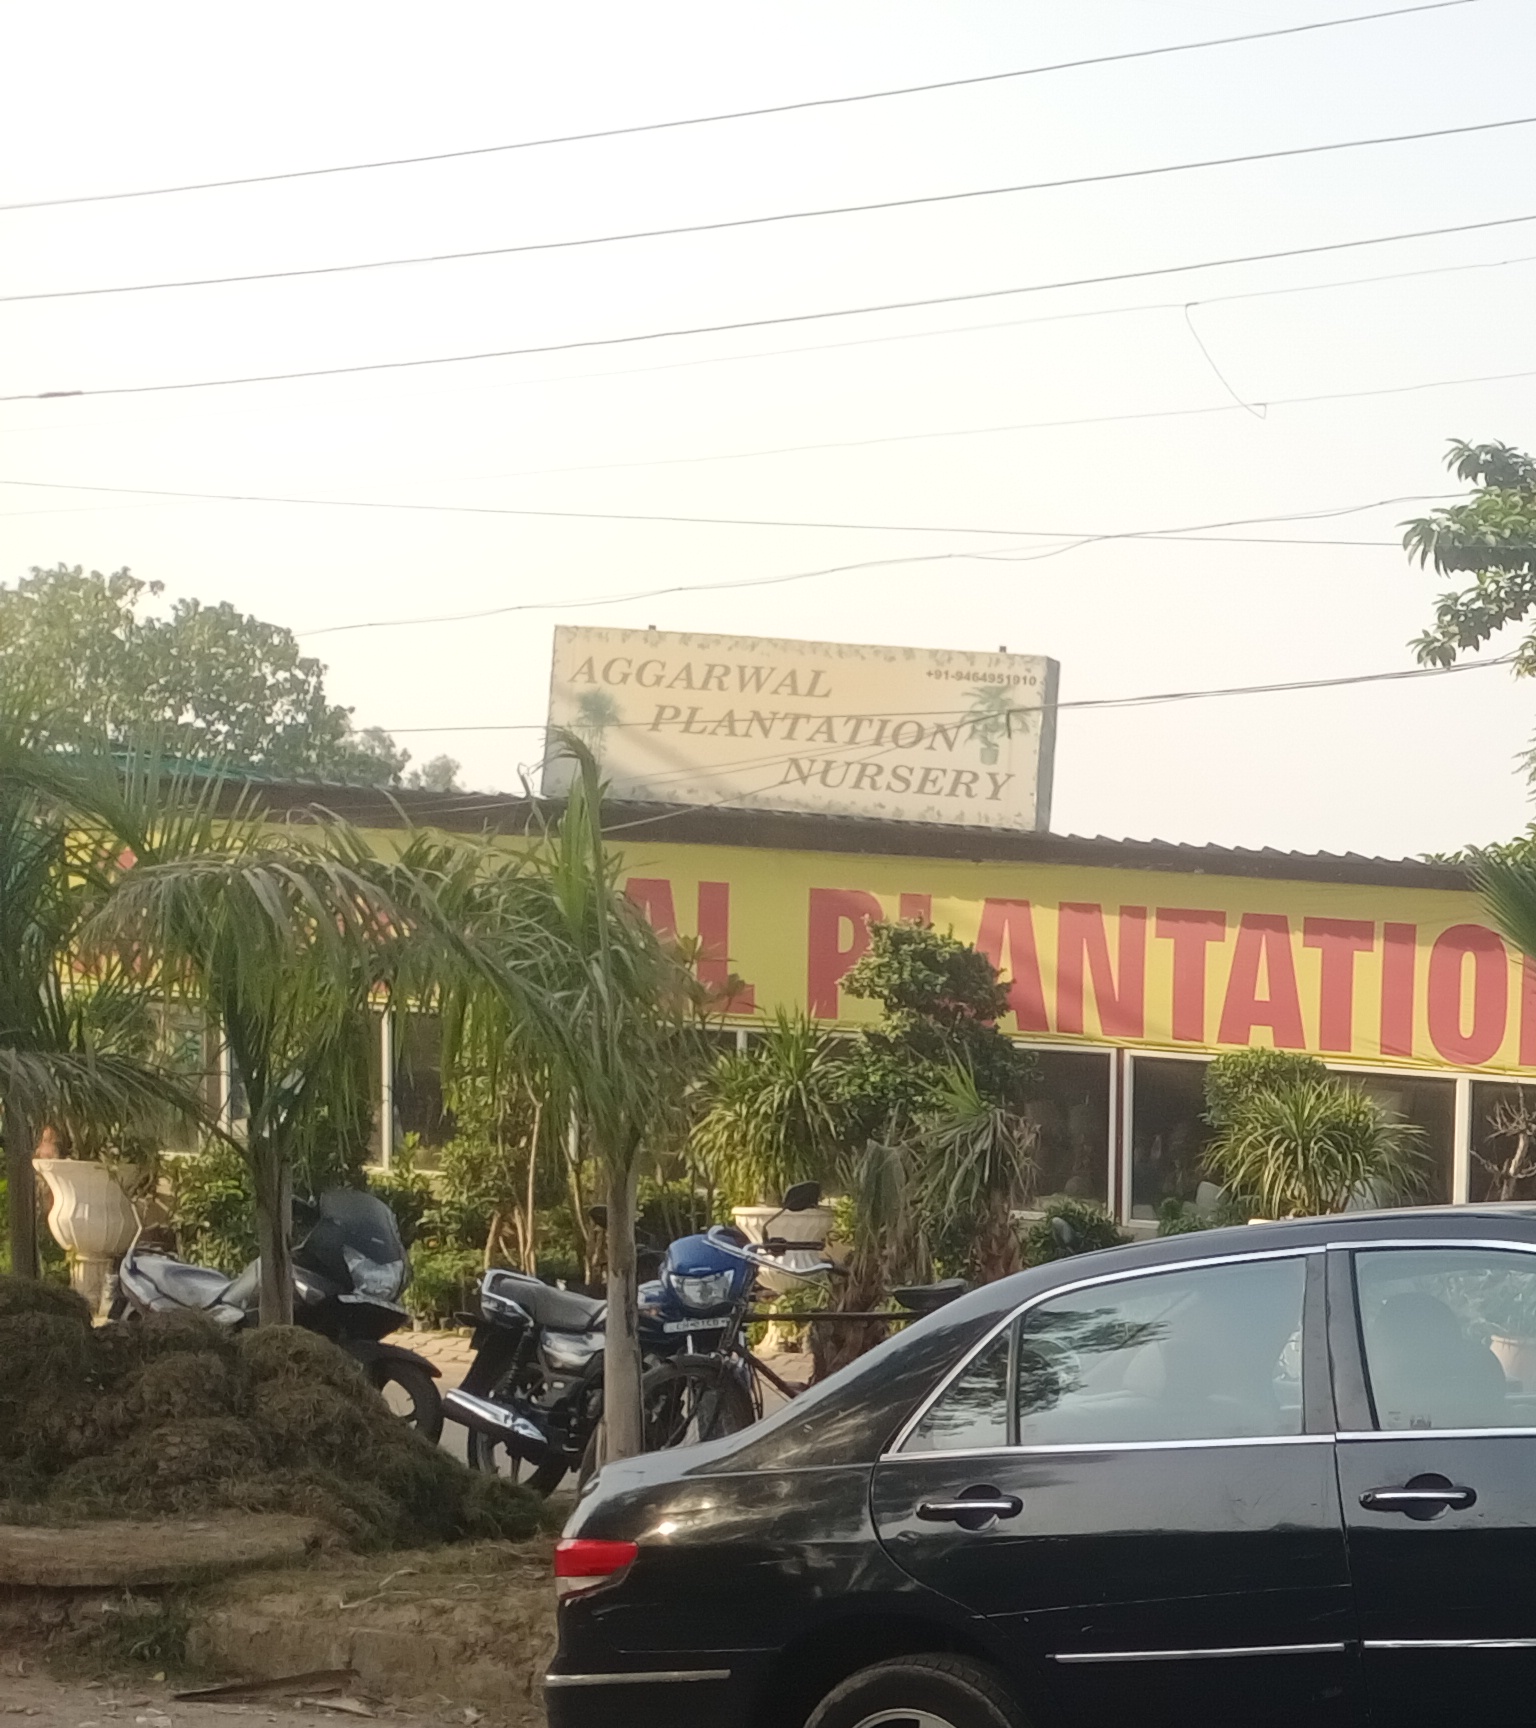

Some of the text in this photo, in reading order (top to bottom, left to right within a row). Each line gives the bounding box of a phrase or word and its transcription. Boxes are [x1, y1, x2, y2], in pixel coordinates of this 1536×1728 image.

[568, 656, 832, 699] AGGARWAL
[648, 704, 974, 753] PLANTATION
[779, 757, 1016, 801] NURSERY
